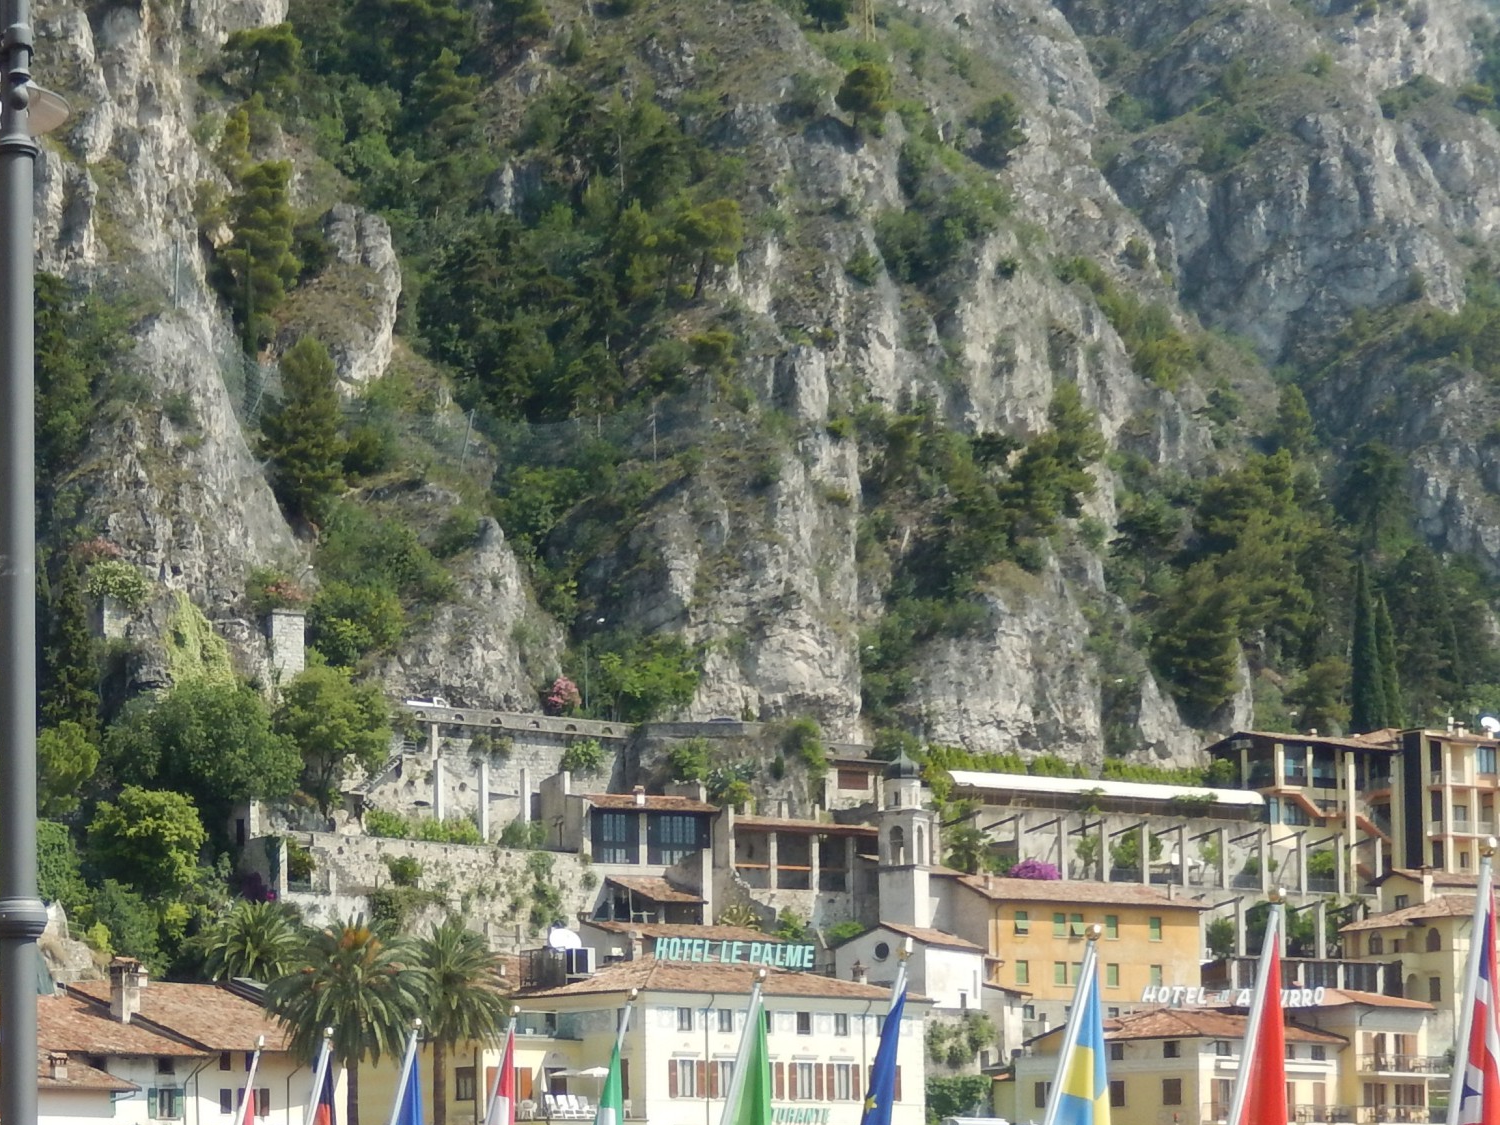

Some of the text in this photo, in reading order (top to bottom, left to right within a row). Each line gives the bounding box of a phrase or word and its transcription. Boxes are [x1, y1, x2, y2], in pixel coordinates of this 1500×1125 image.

[655, 937, 815, 968] HOTEL LE PALME
[1141, 985, 1208, 1005] HOTEL
[1236, 986, 1325, 1007] AURRO
